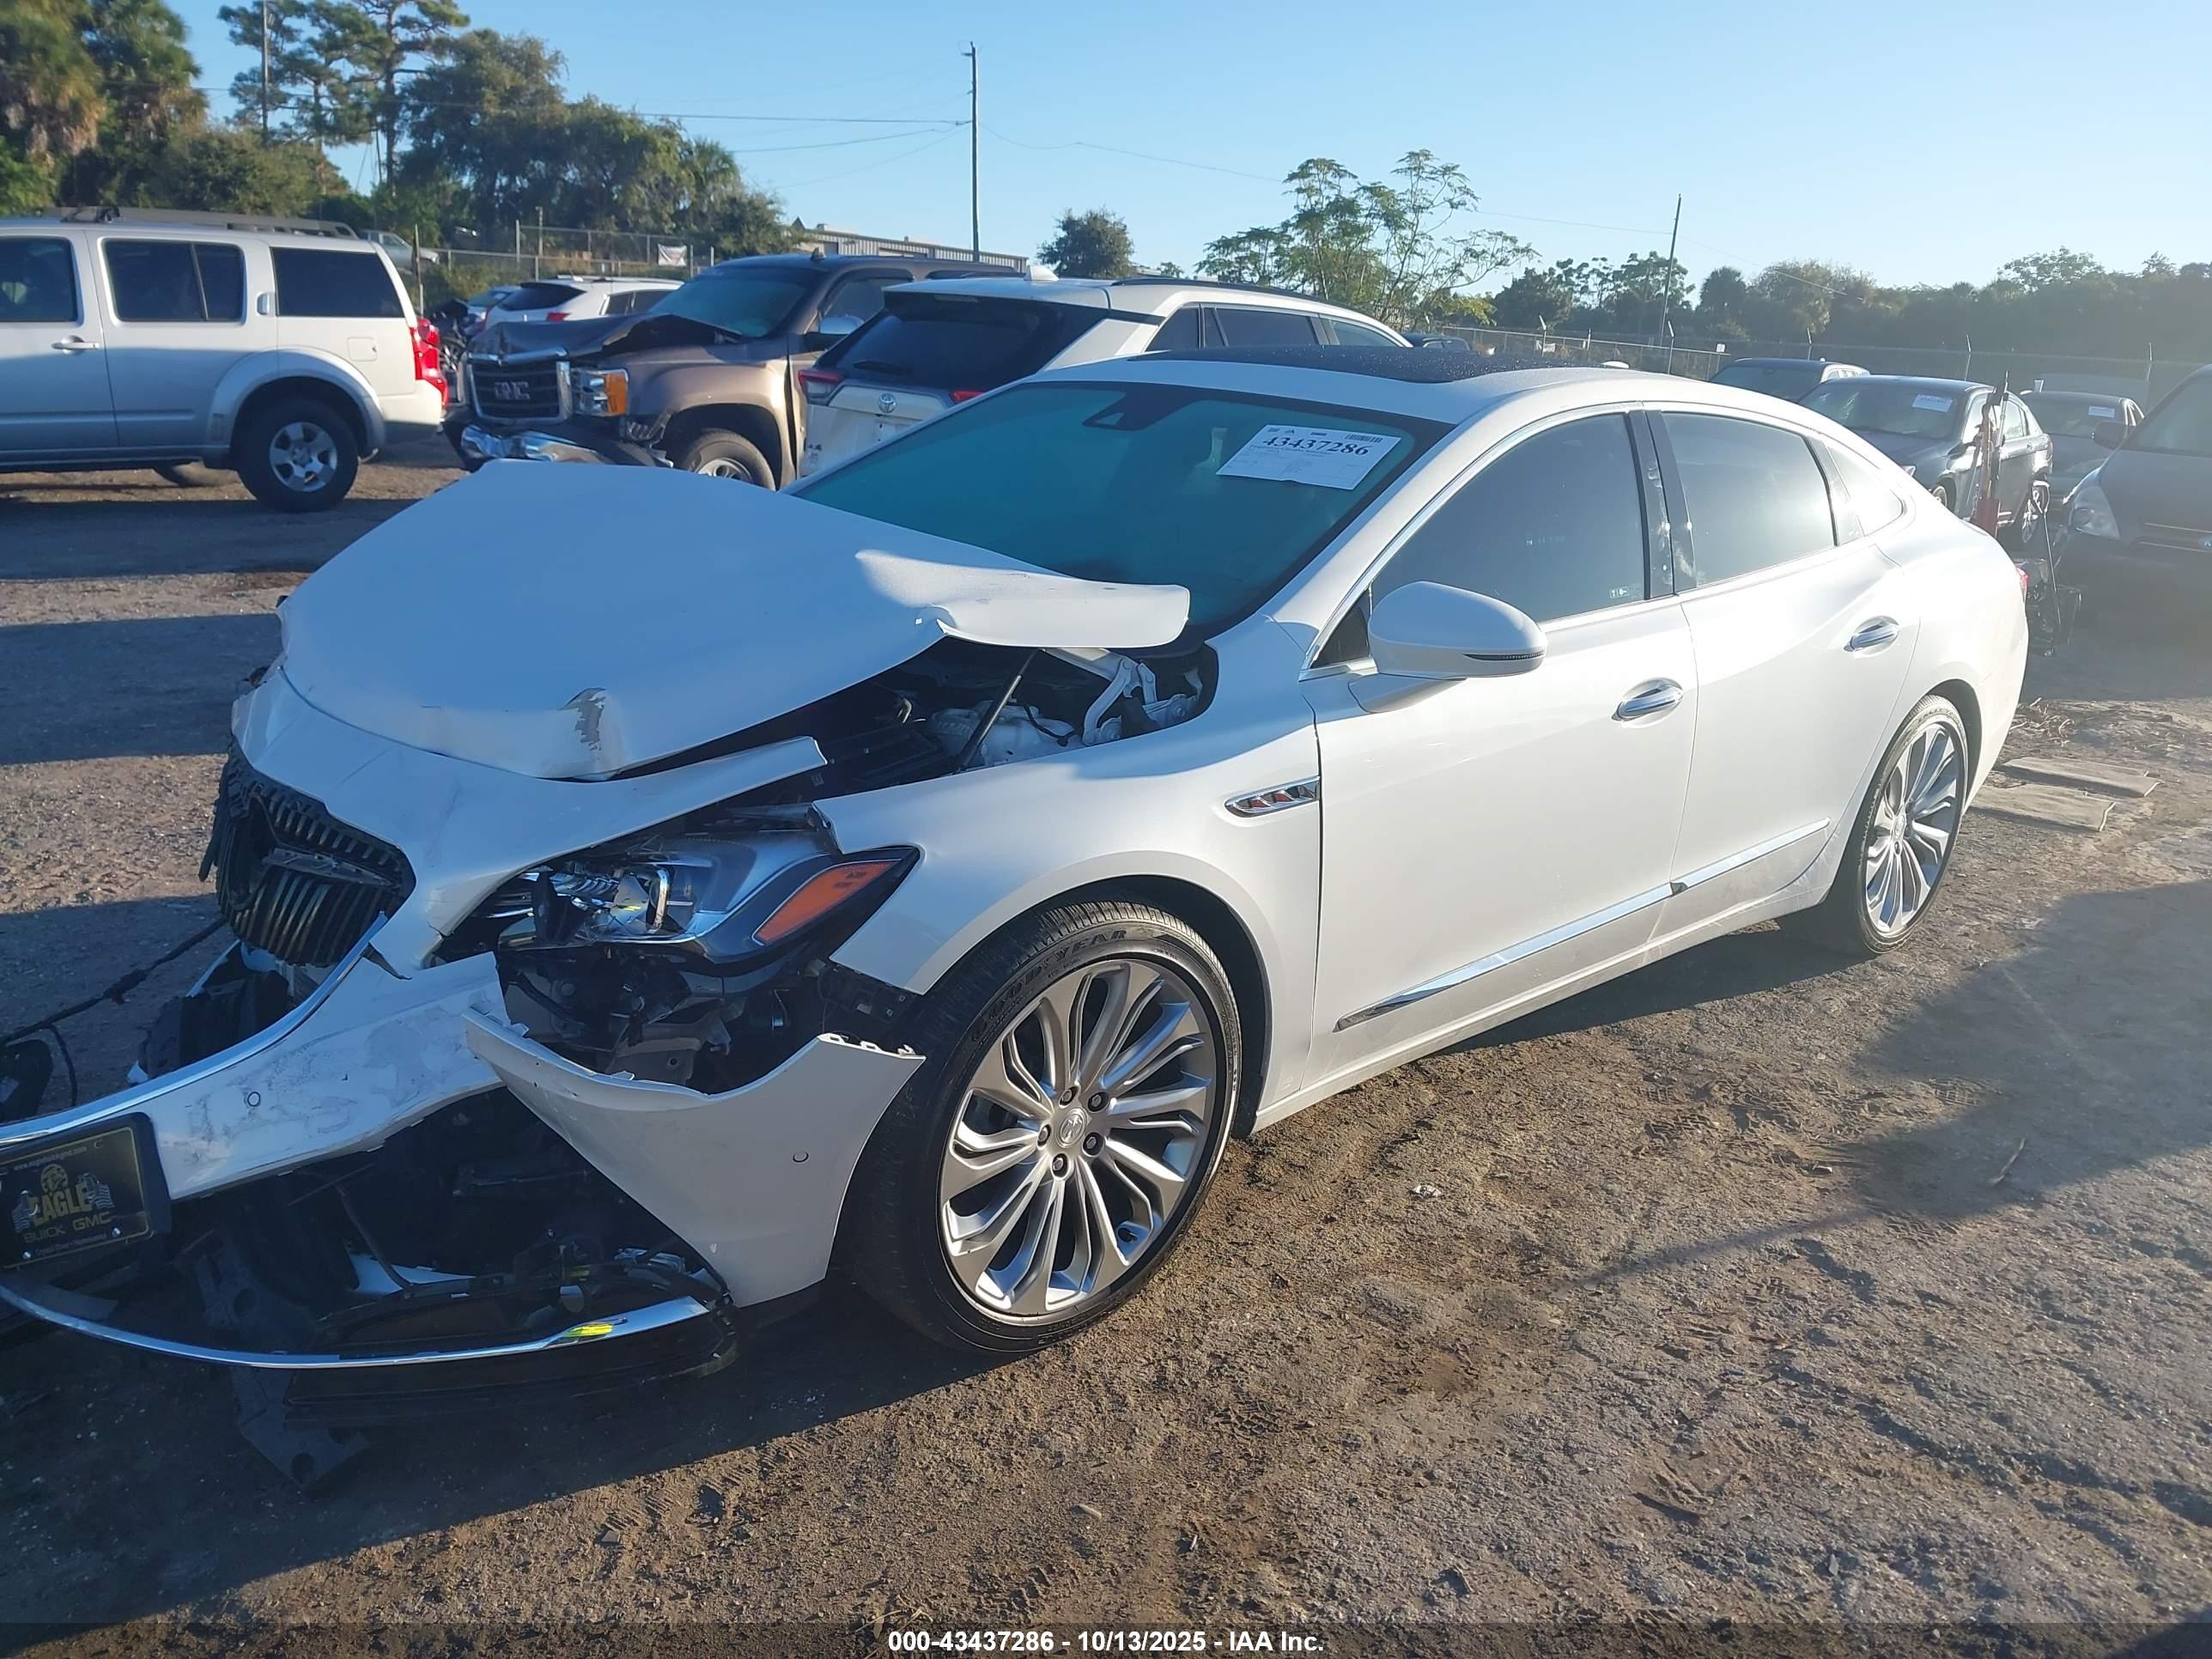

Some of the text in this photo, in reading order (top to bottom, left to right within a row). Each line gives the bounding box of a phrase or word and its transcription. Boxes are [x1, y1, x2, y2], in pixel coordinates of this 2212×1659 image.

[494, 381, 530, 400] GMC
[1263, 435, 1374, 456] 43437286
[27, 1184, 94, 1227] EAGLE
[24, 1212, 112, 1243] BUICK GMC
